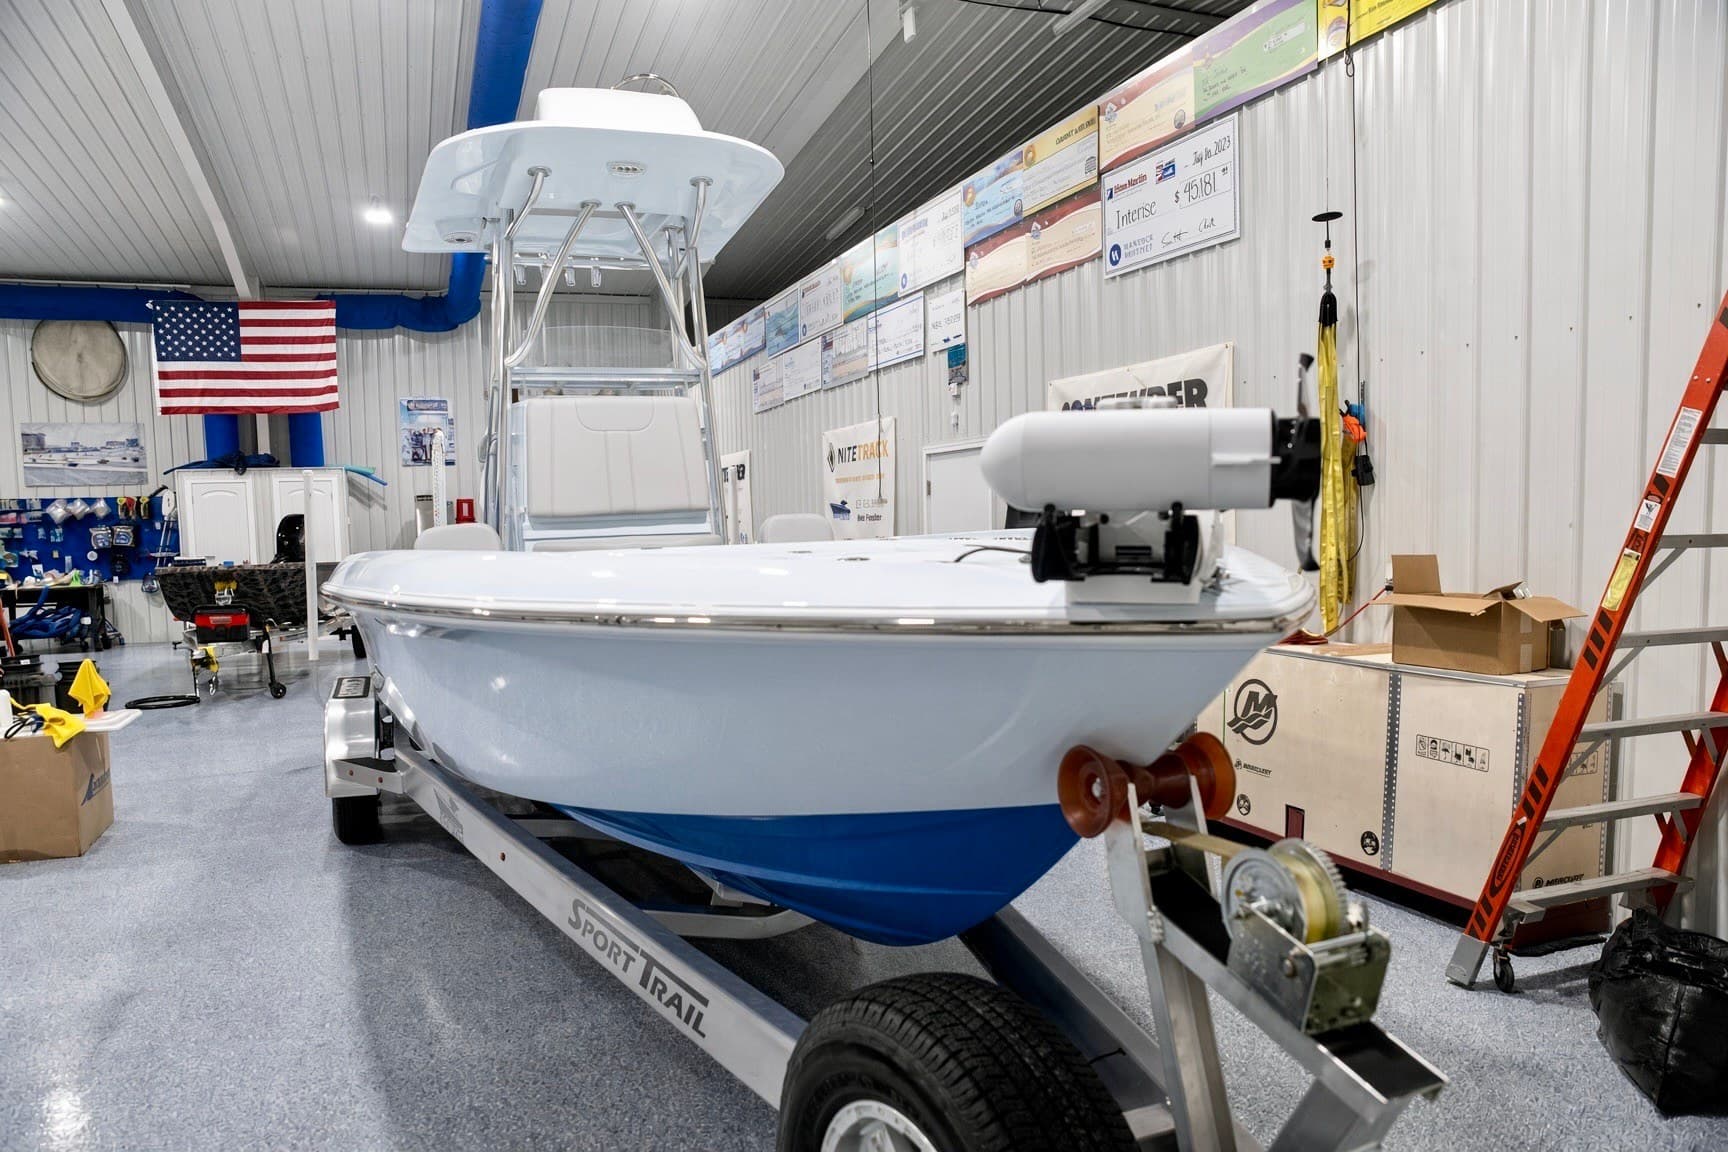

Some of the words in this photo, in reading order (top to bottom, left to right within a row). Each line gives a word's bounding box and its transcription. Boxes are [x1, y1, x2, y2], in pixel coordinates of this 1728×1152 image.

[1214, 136, 1231, 155] 2023
[1545, 874, 1584, 887] MERCURY
[568, 898, 640, 974] SPORT
[639, 948, 710, 1038] TRAIL
